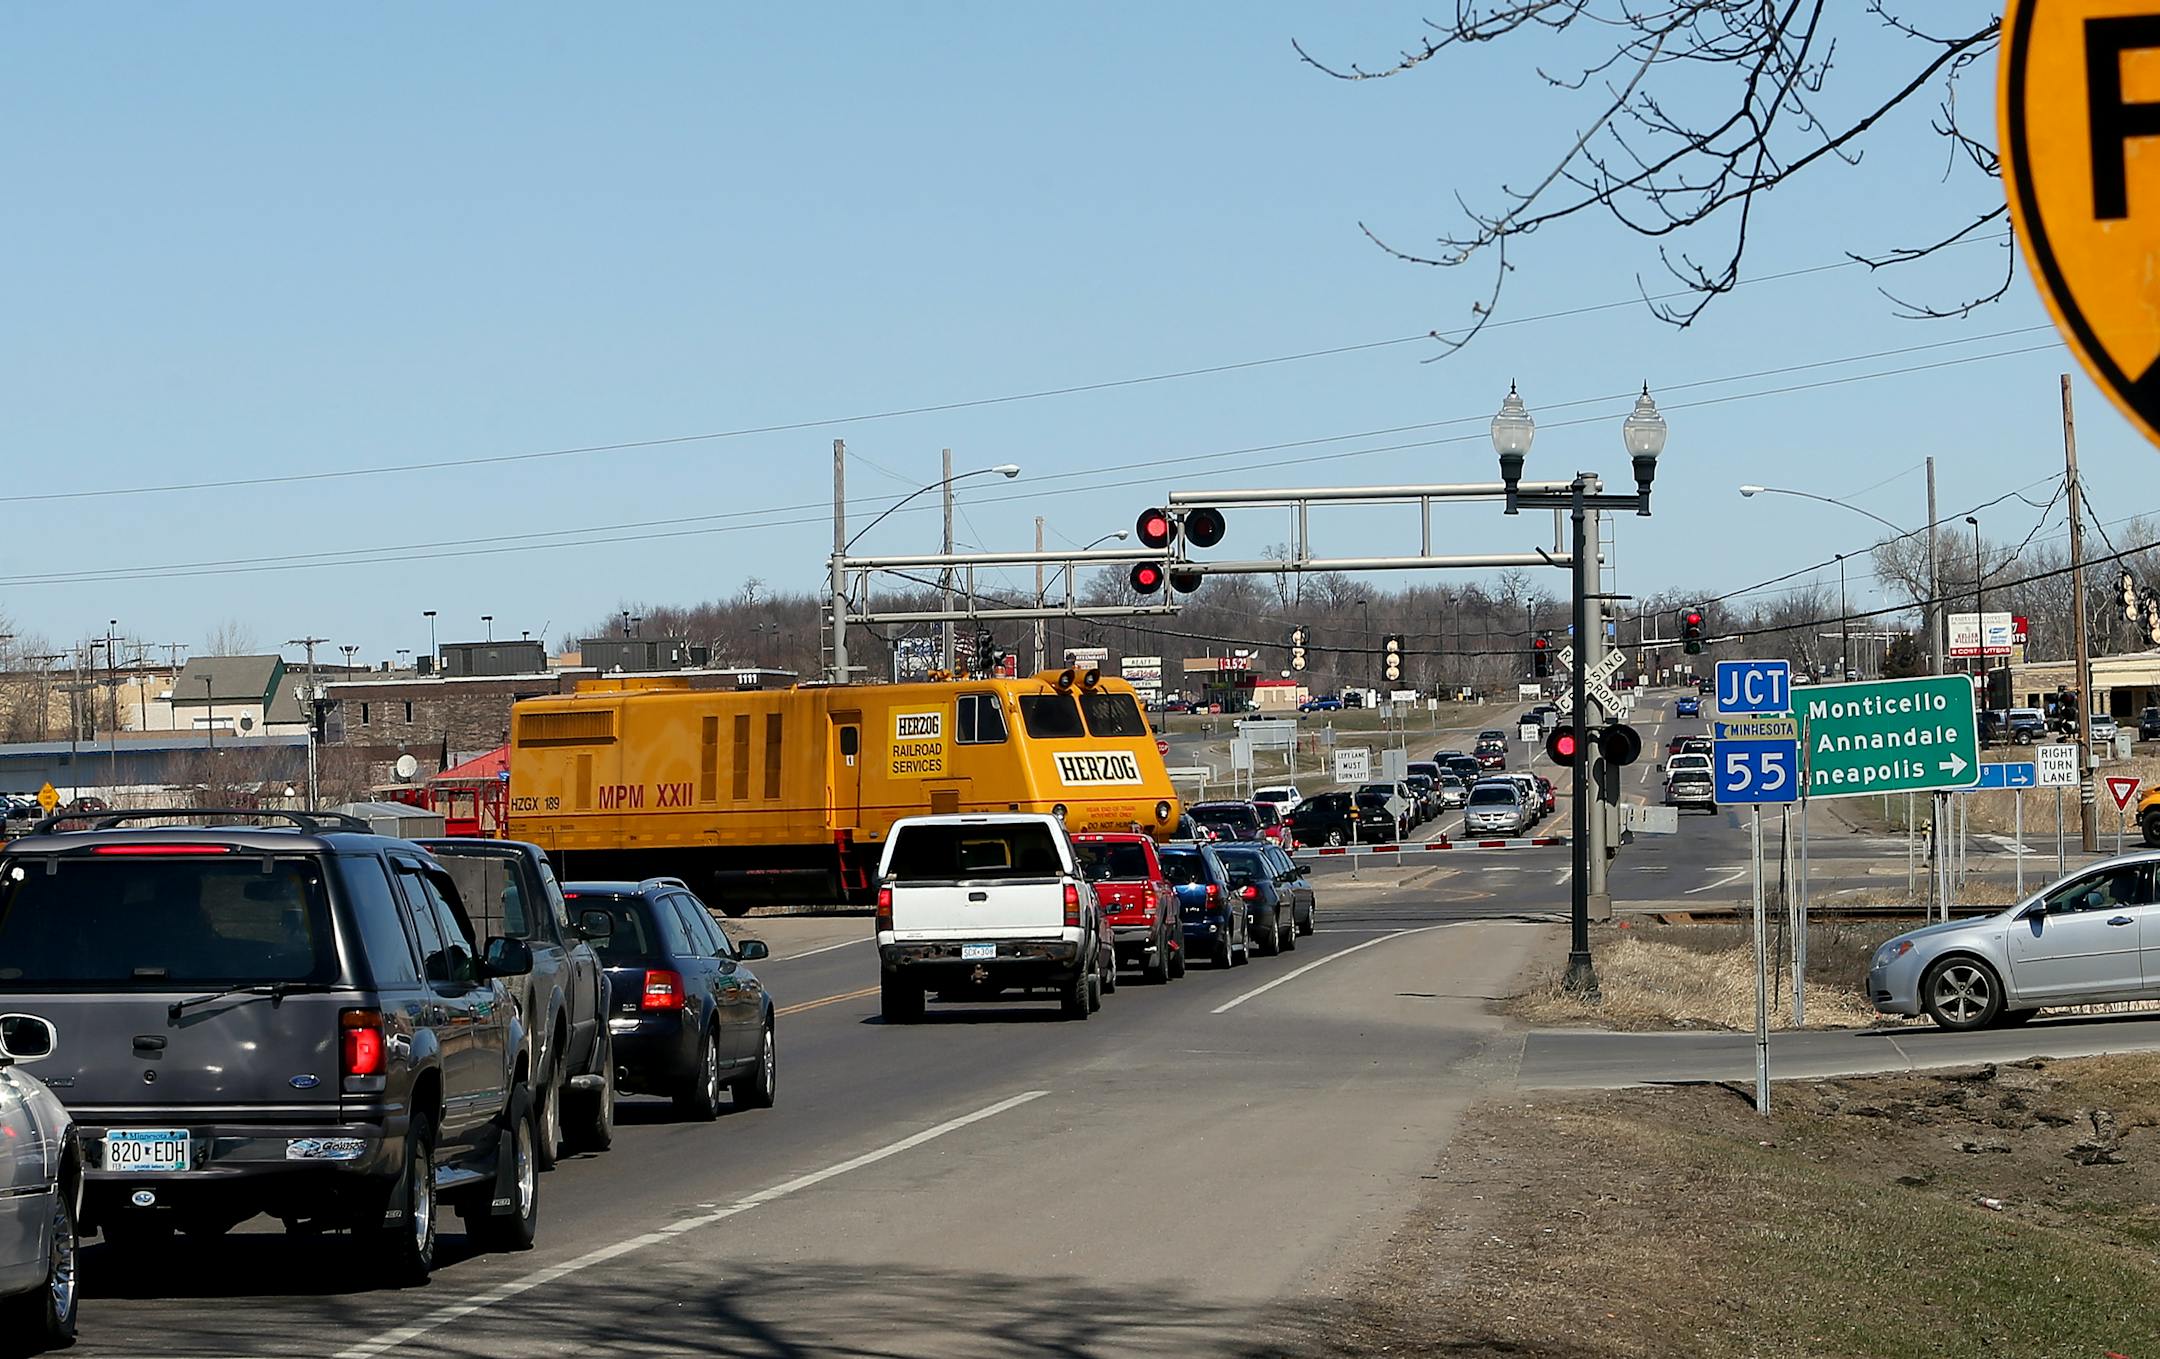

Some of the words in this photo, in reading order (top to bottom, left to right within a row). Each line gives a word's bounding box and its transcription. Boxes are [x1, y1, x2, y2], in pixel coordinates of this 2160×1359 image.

[1978, 646, 2010, 654] UTTERS
[737, 673, 758, 685] 1111
[1721, 670, 1785, 706] JCT
[1809, 692, 1947, 720] Monticello
[898, 716, 939, 736] HERZOG
[1730, 722, 1794, 736] MINNESOTA
[1817, 725, 1958, 753] Annandale
[893, 743, 942, 757] RAILROAD
[2041, 748, 2074, 758] RIGHT
[892, 759, 942, 774] SERVICES
[1058, 756, 1137, 780] HERZOG
[1343, 761, 1361, 769] MUST
[1726, 753, 1786, 791] 55
[2043, 760, 2073, 770] TURN
[2043, 773, 2073, 783] LANE
[600, 784, 644, 809] MPM
[656, 783, 693, 808] XXII
[511, 797, 539, 812] HZGX
[544, 796, 560, 810] 189
[111, 1142, 141, 1162] 820
[154, 1141, 185, 1162] EDH
